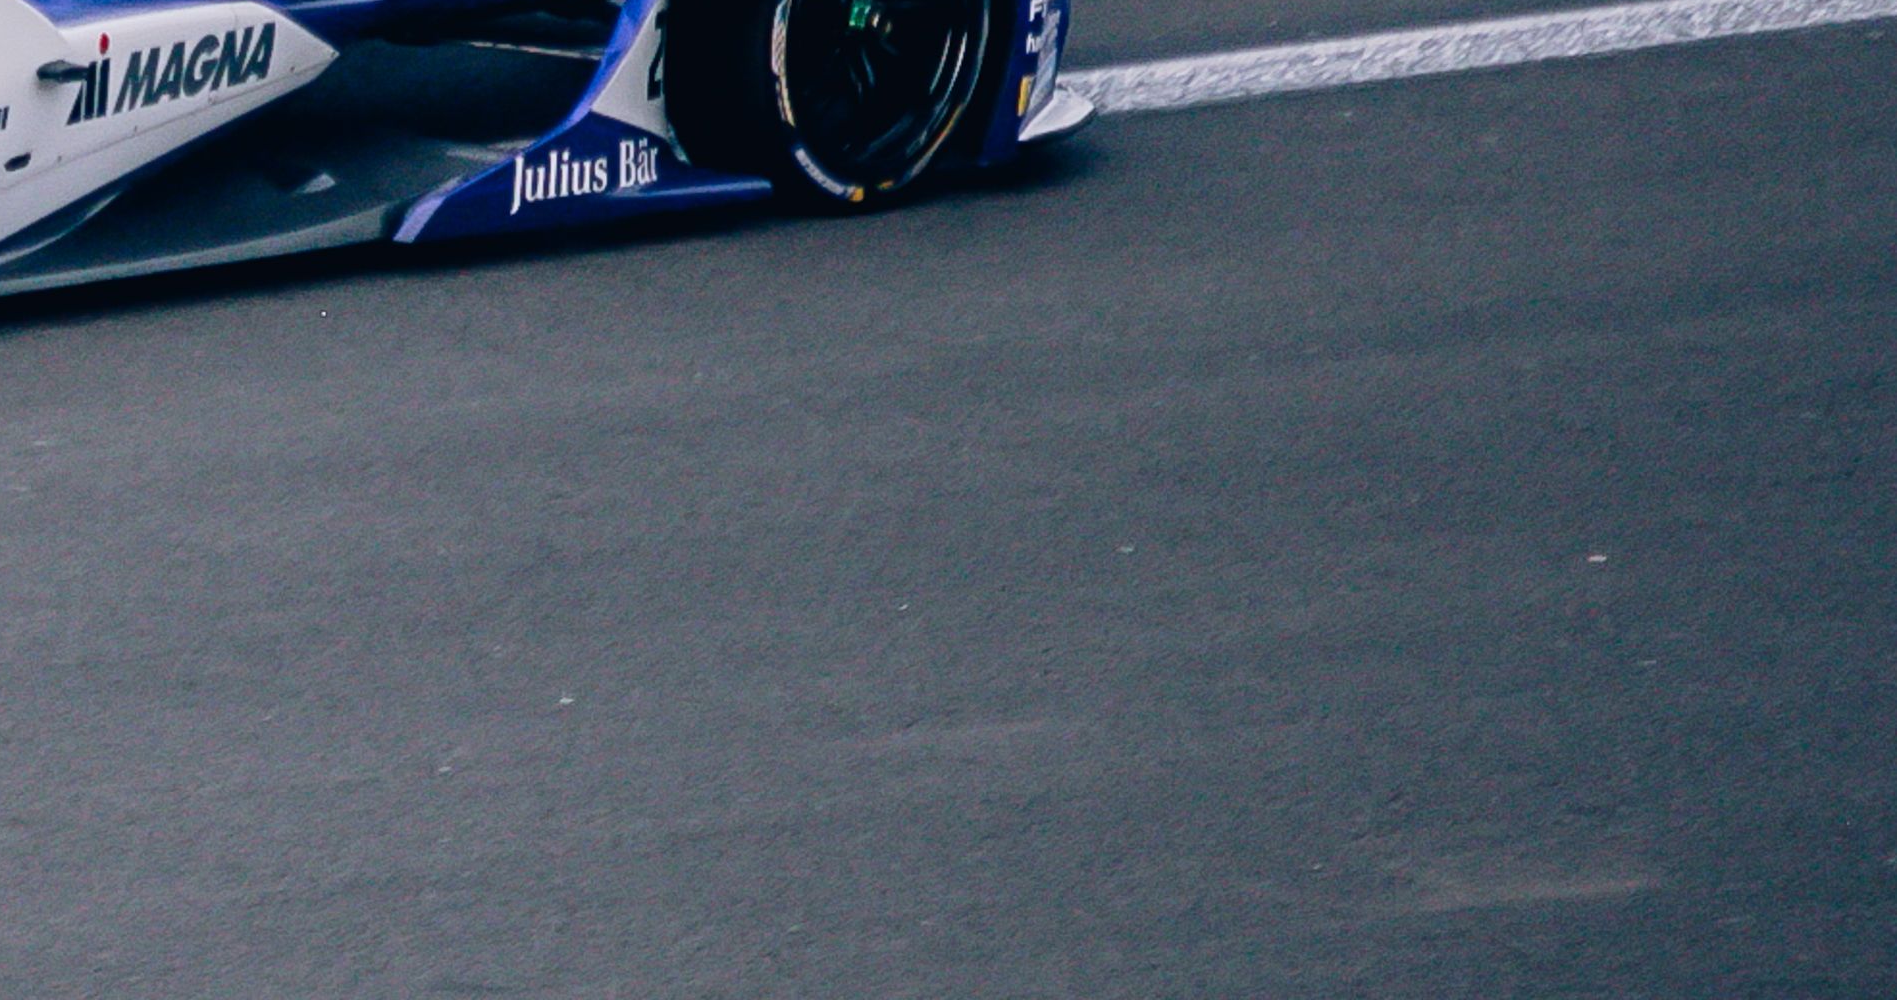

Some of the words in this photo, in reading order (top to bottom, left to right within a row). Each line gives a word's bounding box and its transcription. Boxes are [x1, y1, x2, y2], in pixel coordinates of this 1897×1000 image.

[111, 21, 274, 115] MAGNA
[510, 149, 608, 216] Julius
[619, 137, 659, 189] Bär
